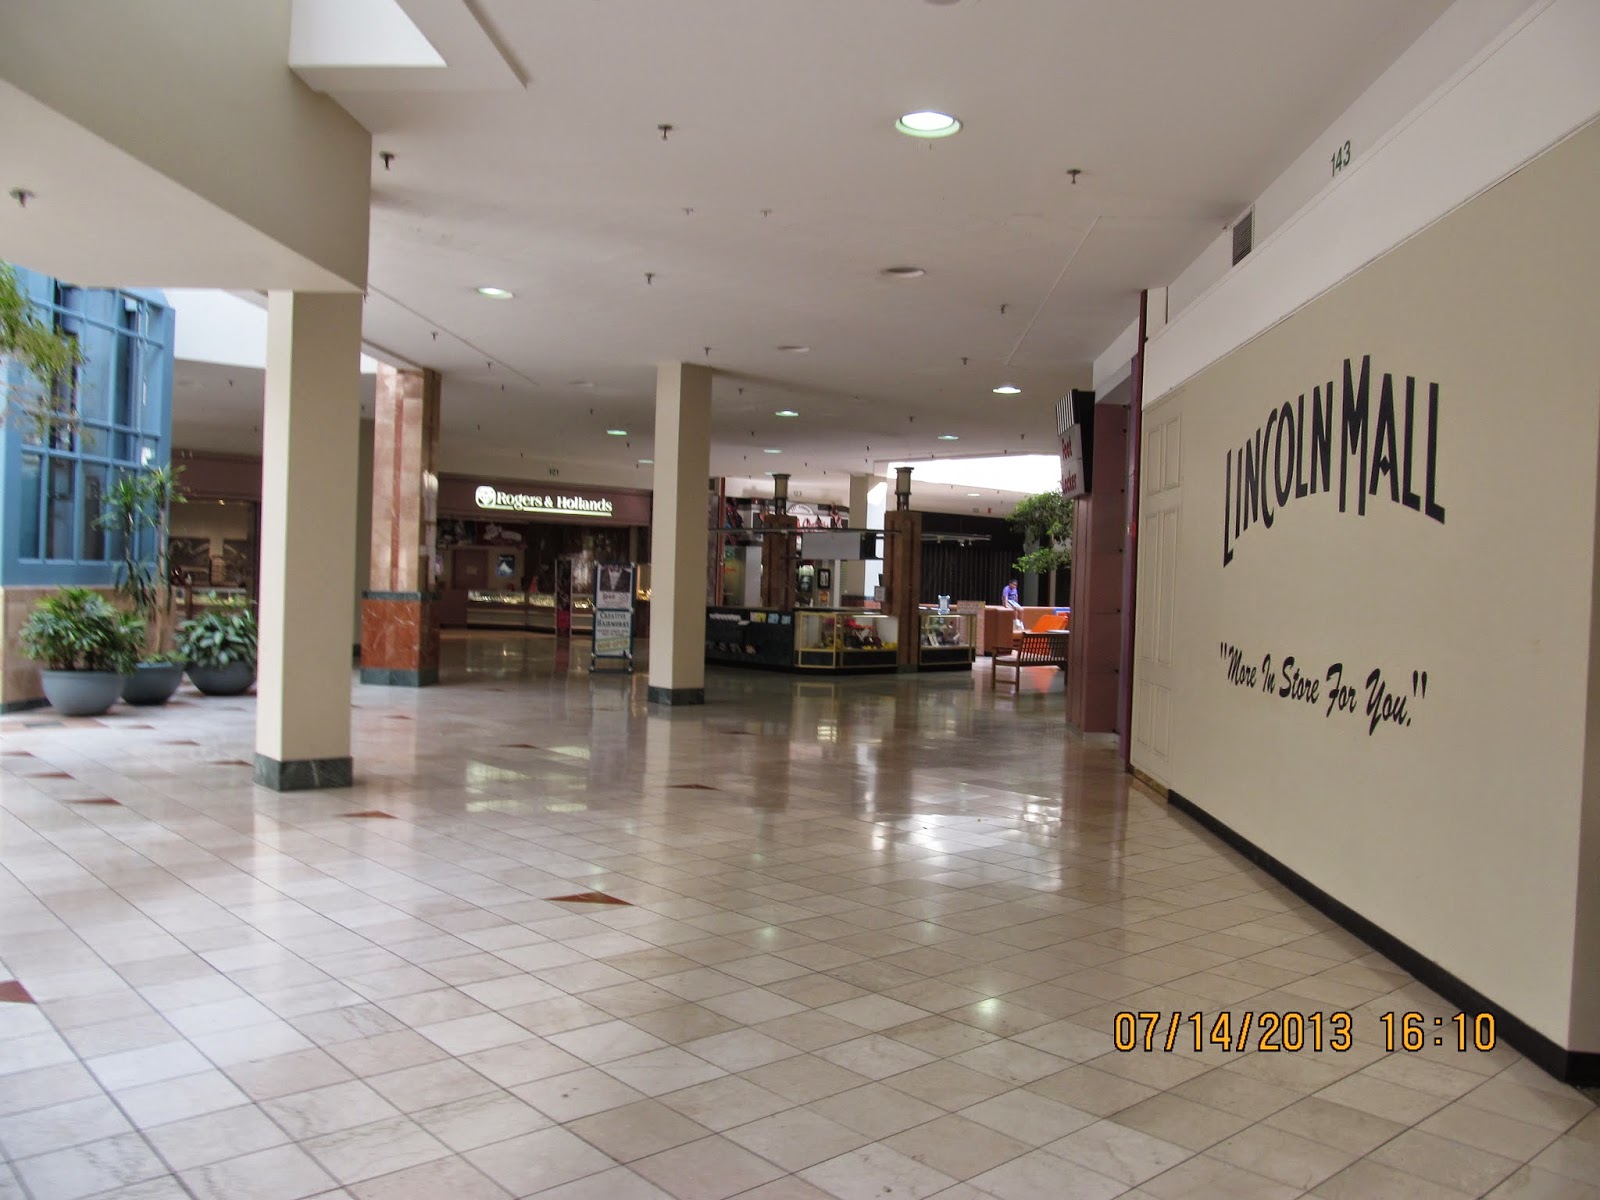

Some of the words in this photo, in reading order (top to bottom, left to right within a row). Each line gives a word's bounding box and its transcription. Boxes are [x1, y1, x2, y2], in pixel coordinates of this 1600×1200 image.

[1330, 139, 1351, 178] 143
[1062, 435, 1073, 460] Foot
[1223, 381, 1334, 568] LINCOLN
[1338, 354, 1446, 525] MALL
[1062, 469, 1077, 495] Locker
[496, 491, 543, 511] Rogers
[544, 495, 554, 508] &
[557, 496, 613, 512] Hollands
[1220, 641, 1256, 687] "More
[1262, 653, 1275, 693] In
[1279, 656, 1320, 705] Store
[1326, 662, 1358, 718] For
